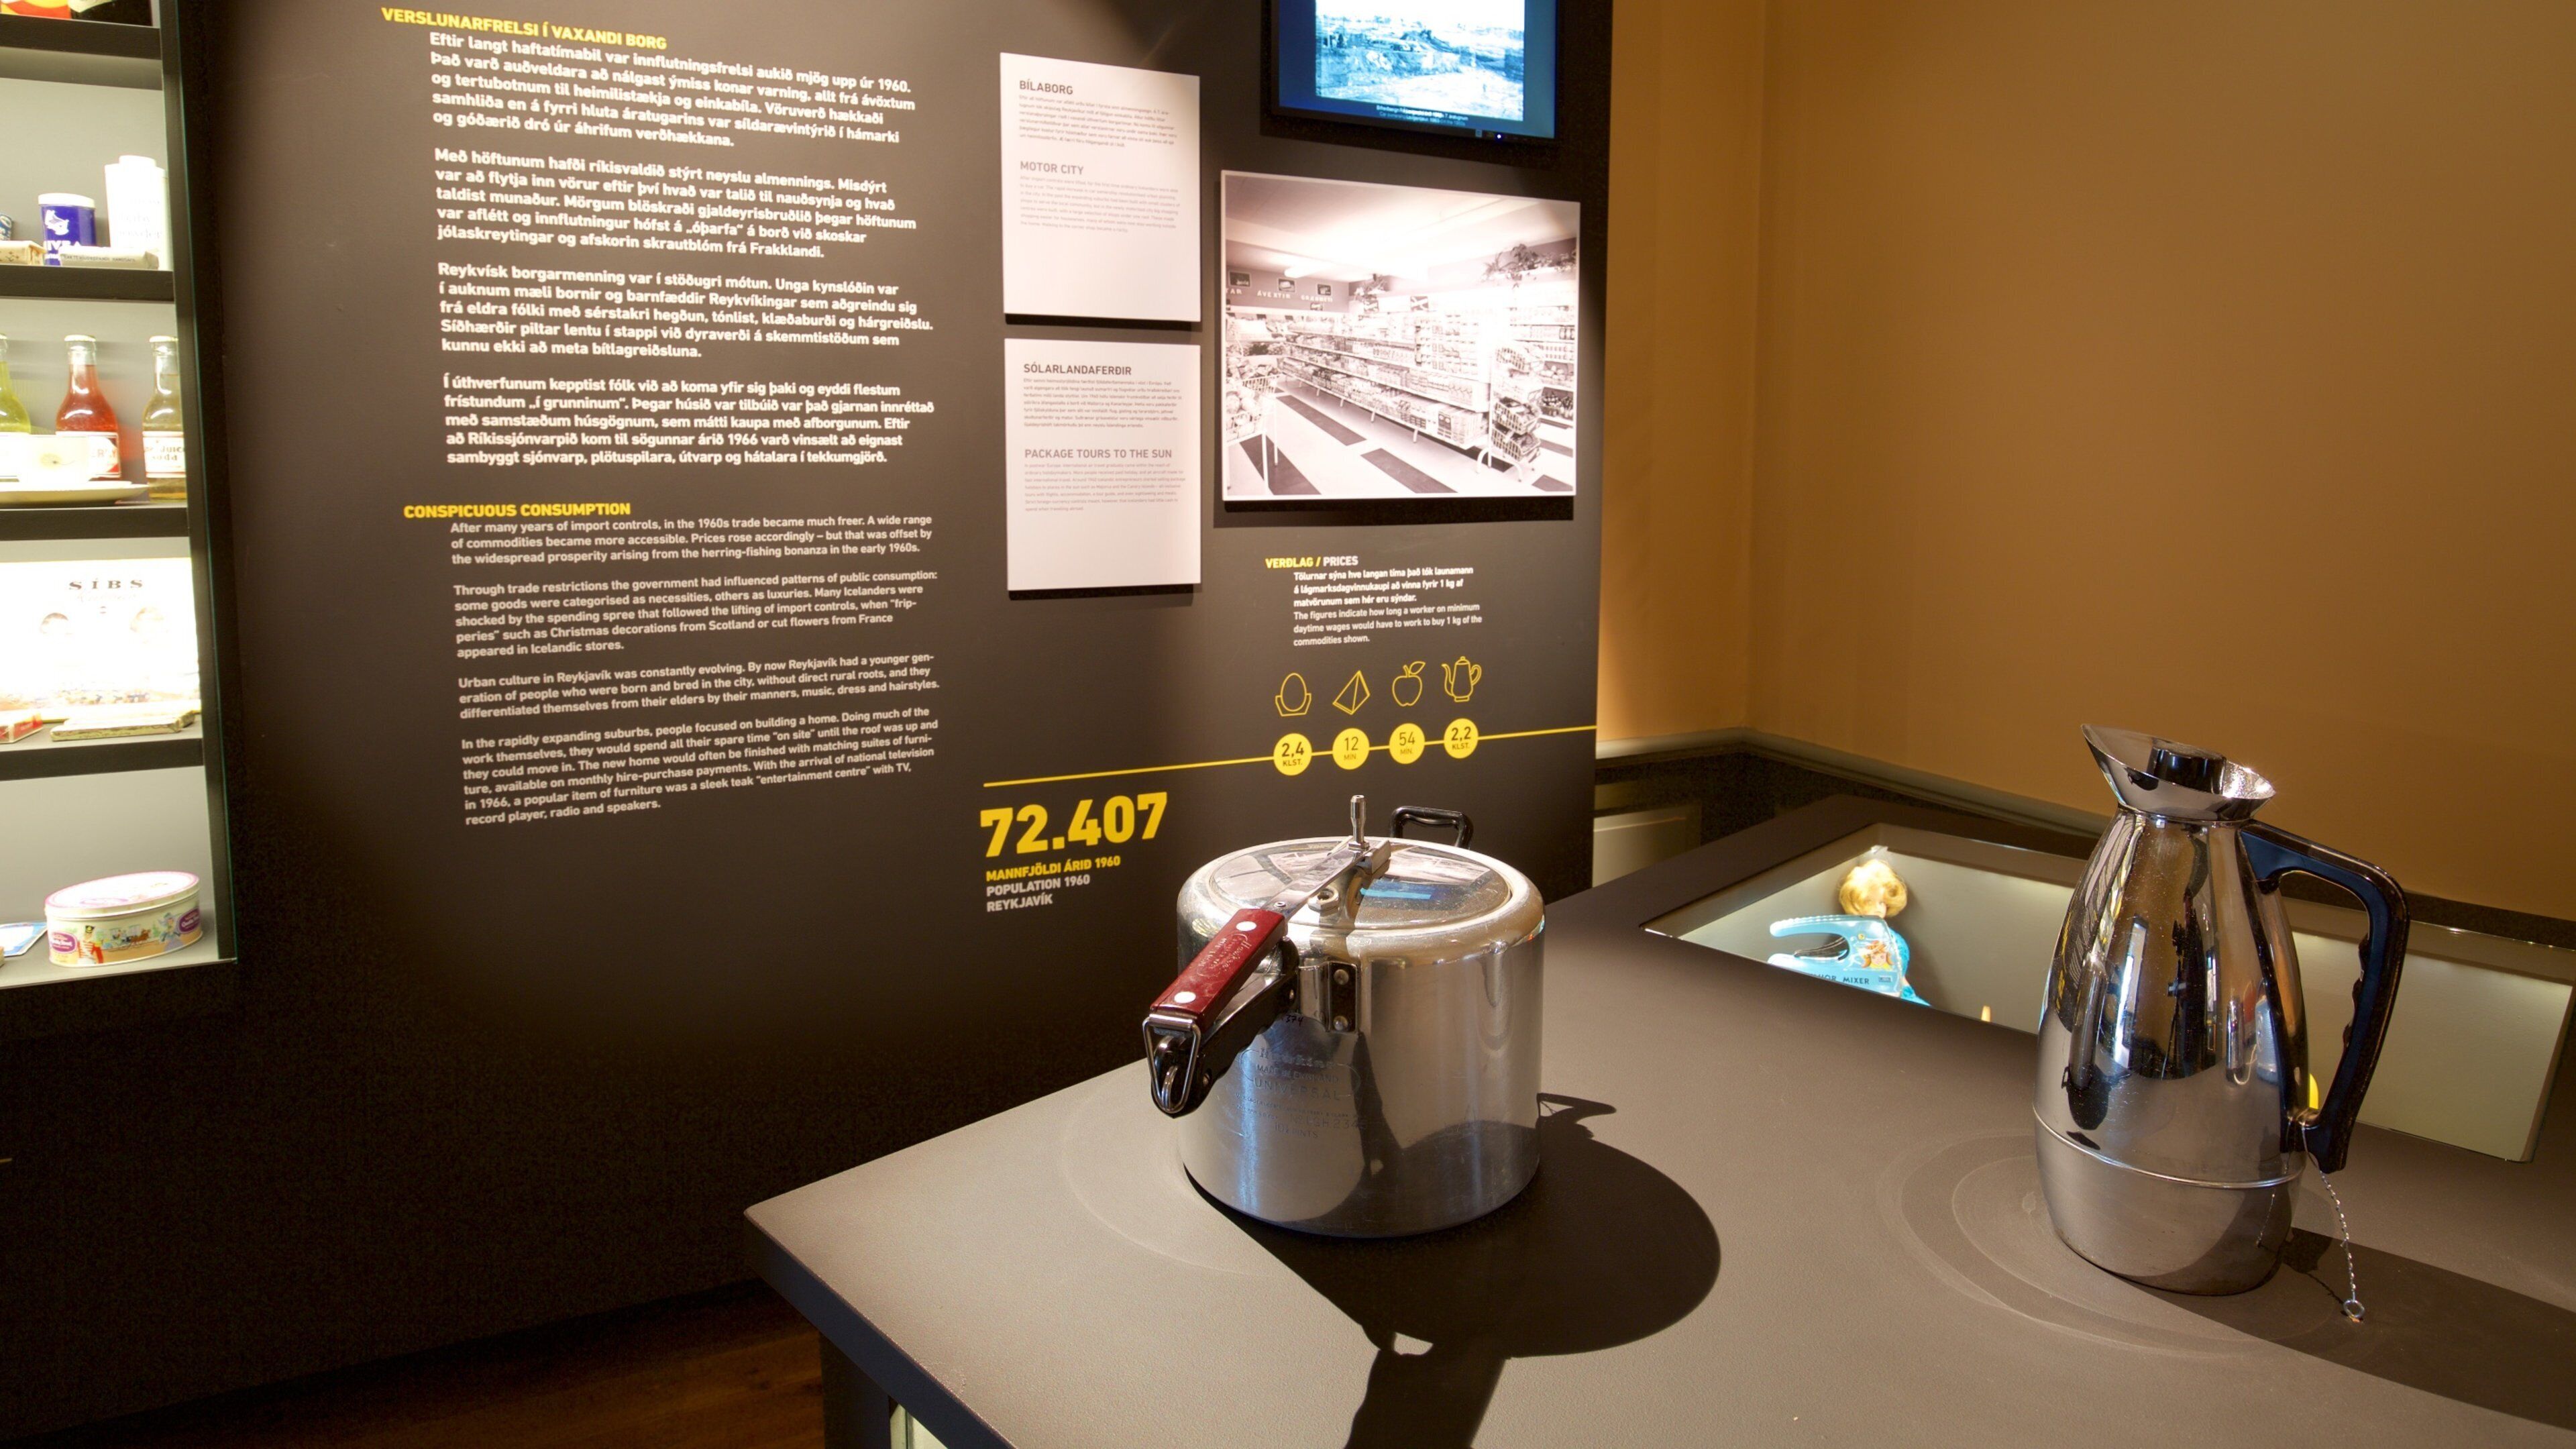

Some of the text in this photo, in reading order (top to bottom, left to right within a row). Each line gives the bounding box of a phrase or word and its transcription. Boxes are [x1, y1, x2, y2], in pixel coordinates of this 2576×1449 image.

[381, 7, 667, 50] VERSLUNARFRELSI Í VAXANDI BORG
[1020, 79, 1073, 95] BÍLABORG
[431, 74, 883, 124] og tertubotnum til heimilistækja og einkabíla. Vöruverð hækkaði
[1020, 161, 1084, 175] MOTOR CITY
[436, 187, 916, 229] taldist munaður. Mörgum blöskraði gjaldeyrisbruðlið þegar höftunum
[438, 262, 899, 294] Reykvísk borgarmenning var í stöðugri mótun. Unga kynslóðin var
[1024, 362, 1132, 375] SÓLARLANDAFERÐIR
[447, 451, 887, 466] sambyggt sjónvarp, plötuspilara, útvarp og hátalara í tekkumgjörð.
[1024, 449, 1172, 458] PACKAGE TOURS TO THE SUN
[404, 503, 631, 518] CONSPICUOUS CONSUMPTION
[452, 543, 920, 565] the widespread prosperity arising from the herring-fishing bonanza in the early 1960s.
[1265, 557, 1313, 568] VERÐLAG
[1324, 555, 1358, 566] PRICES
[1293, 572, 1327, 580] Tölurnar
[1329, 571, 1346, 581] sýna
[1348, 570, 1362, 578] hve
[1363, 570, 1388, 580] langan
[1389, 569, 1405, 577] tíma
[1407, 568, 1421, 578] það
[1422, 568, 1433, 576] tók
[1294, 585, 1299, 594] á
[1401, 581, 1421, 589] vinna
[1422, 580, 1438, 590] fyrir
[1446, 580, 1454, 589] kg
[1456, 578, 1463, 586] af
[1294, 598, 1342, 606] matvörunum
[1362, 595, 1375, 604] hér
[1391, 594, 1417, 604] sýndar.
[1293, 612, 1308, 620] The
[1310, 611, 1337, 621] figures
[1339, 609, 1367, 617] indicate
[1386, 608, 1402, 616] long
[1447, 604, 1480, 612] minimum
[1293, 625, 1324, 634] daytime
[1326, 624, 1350, 632] wages
[1352, 621, 1374, 629] would
[1403, 619, 1421, 627] work
[1432, 617, 1445, 626] buy
[1452, 616, 1461, 625] kg
[1293, 636, 1342, 646] commodities
[458, 641, 624, 659] appeared in Icelandic stores.
[460, 680, 939, 718] differentiated themselves from their elders by their manners, music, dress and hairstyles.
[1399, 732, 1415, 746] 54
[1451, 727, 1471, 741] 2,2
[1281, 742, 1304, 757] 2,4
[1344, 737, 1358, 751] 12
[1452, 742, 1470, 750] KLST.
[980, 792, 1167, 857] 72.407
[986, 855, 1121, 881] MANNFJÖLDI ÁRIÐ 1960
[986, 874, 1090, 897] POPULATION 1960
[987, 893, 1053, 912] REYKJAVÍK
[1843, 977, 1870, 985] MIXER
